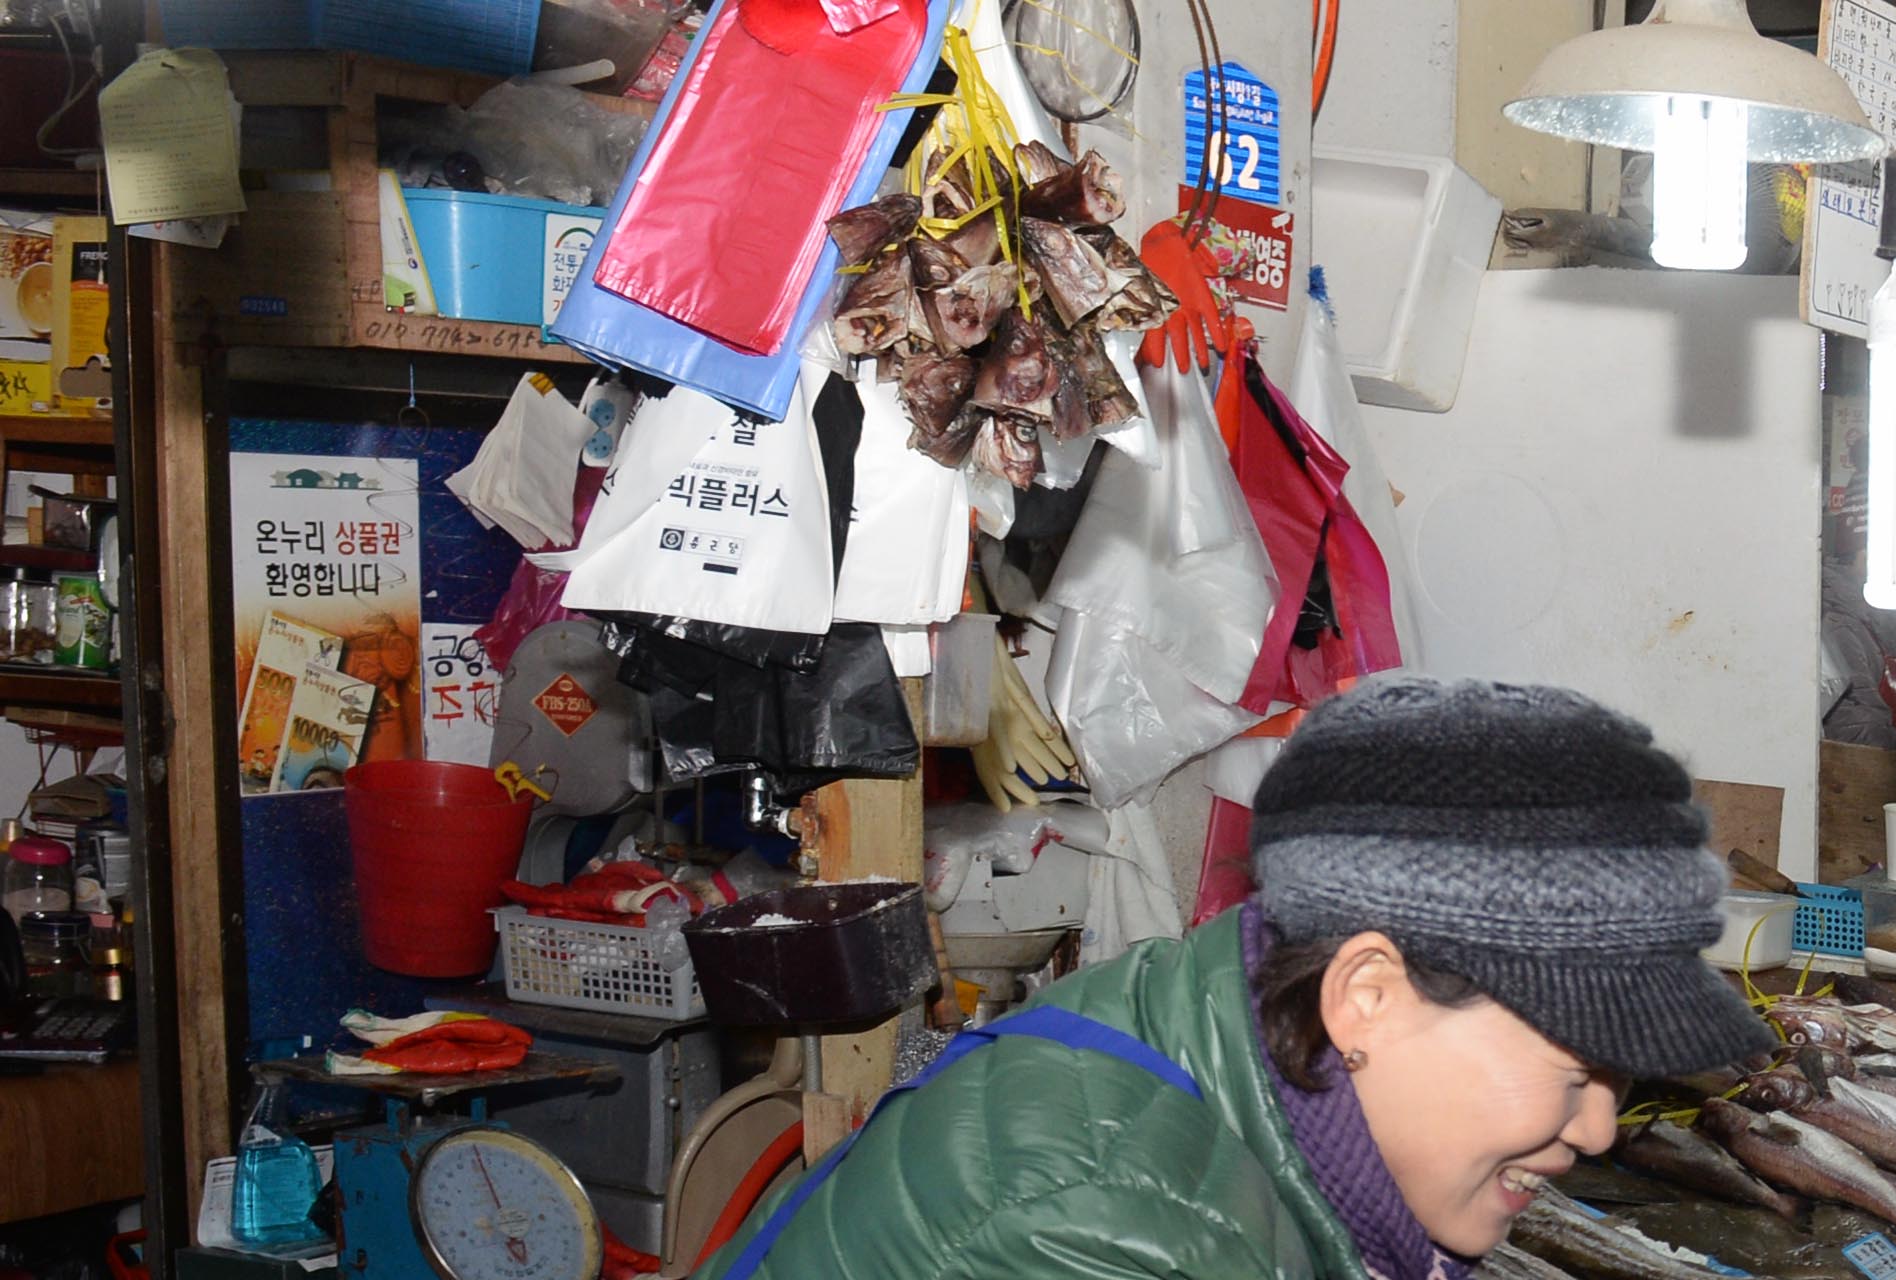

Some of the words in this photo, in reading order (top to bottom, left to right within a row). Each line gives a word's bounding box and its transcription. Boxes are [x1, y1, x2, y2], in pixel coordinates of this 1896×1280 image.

[1209, 130, 1261, 191] 62
[256, 519, 326, 555] 온누리
[335, 520, 400, 556] 상품권
[265, 561, 380, 597] 환영합니다
